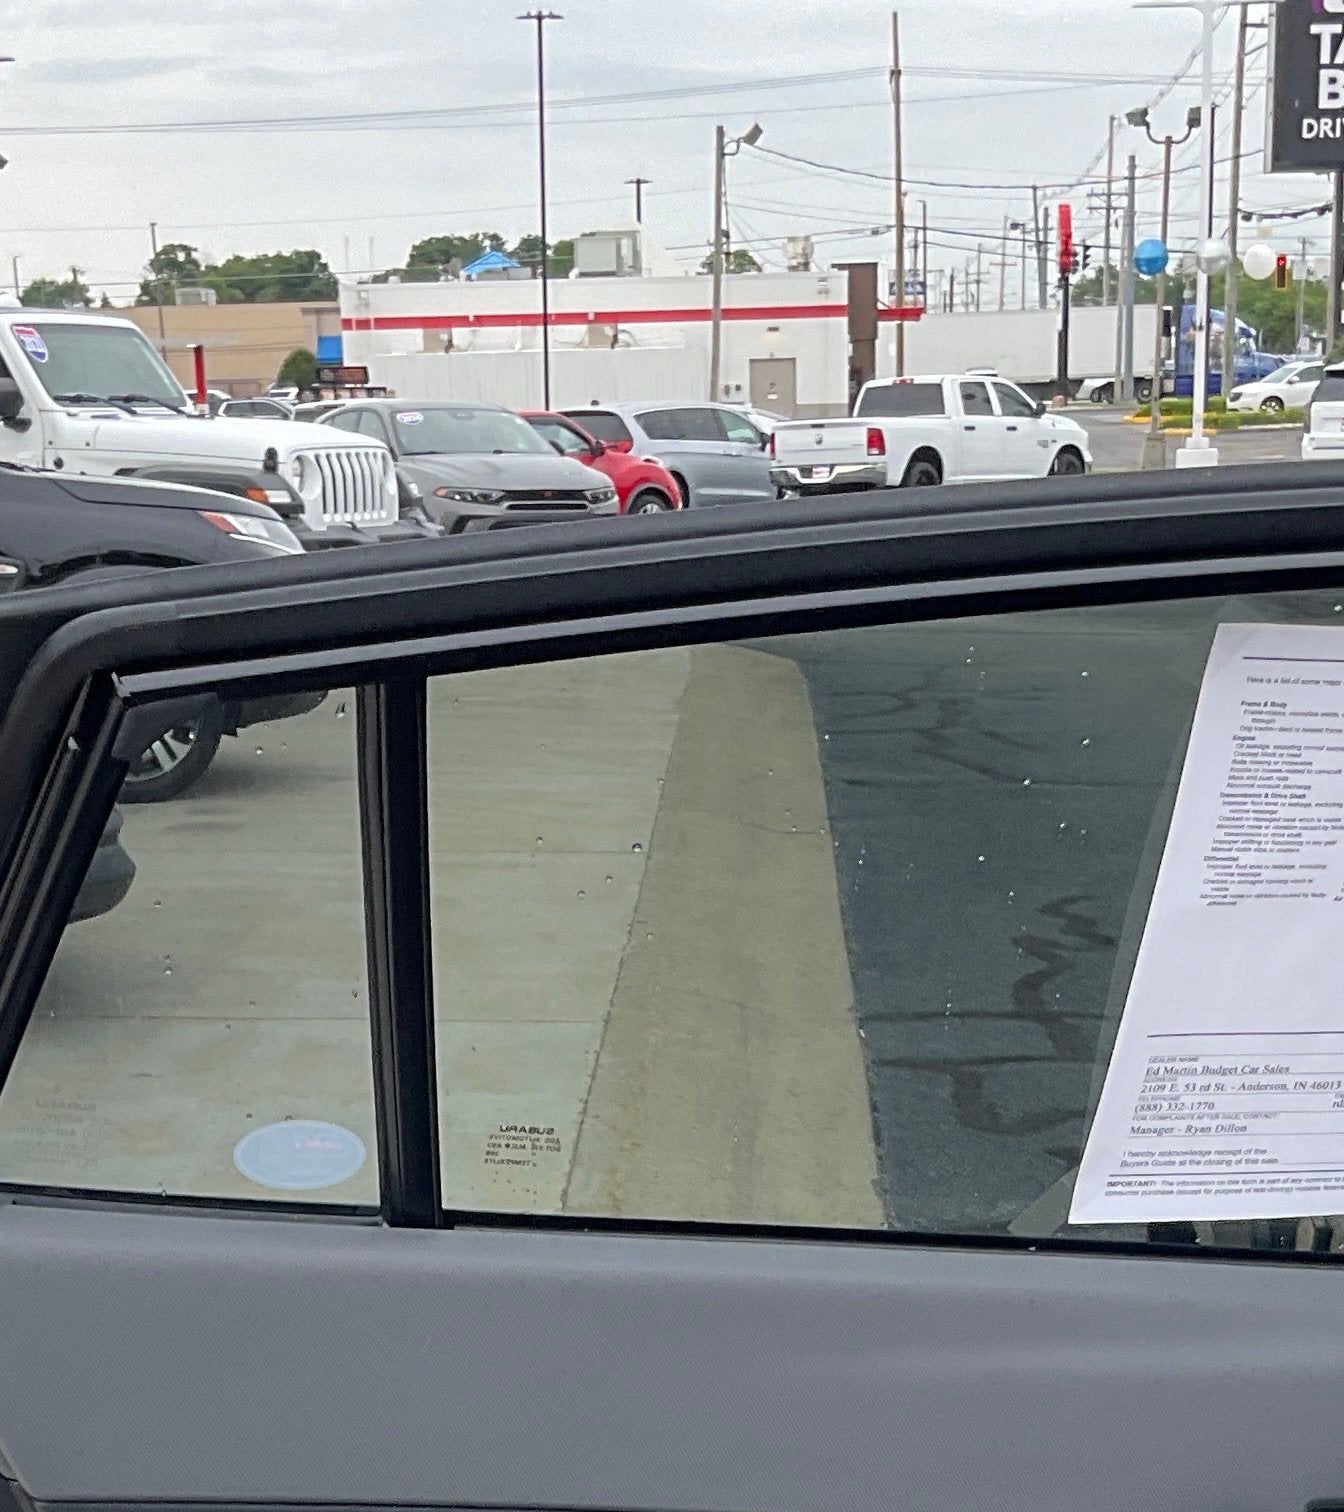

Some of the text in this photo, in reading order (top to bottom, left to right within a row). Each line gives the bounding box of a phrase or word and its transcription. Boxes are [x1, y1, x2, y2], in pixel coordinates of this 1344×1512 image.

[1163, 1066, 1198, 1076] Martin
[1199, 1064, 1239, 1077] Budget
[1241, 1065, 1261, 1074] Car
[1263, 1064, 1290, 1074] Sales
[1141, 1083, 1167, 1093] 2109
[1183, 1082, 1197, 1092] 53
[1237, 1080, 1289, 1092] Anderson,
[1292, 1080, 1308, 1090] IN
[1311, 1079, 1342, 1090] 46013
[1134, 1102, 1163, 1114] (888)
[1129, 1125, 1175, 1136] Manager
[1184, 1124, 1212, 1135] Ryan
[1215, 1123, 1248, 1133] Dillon
